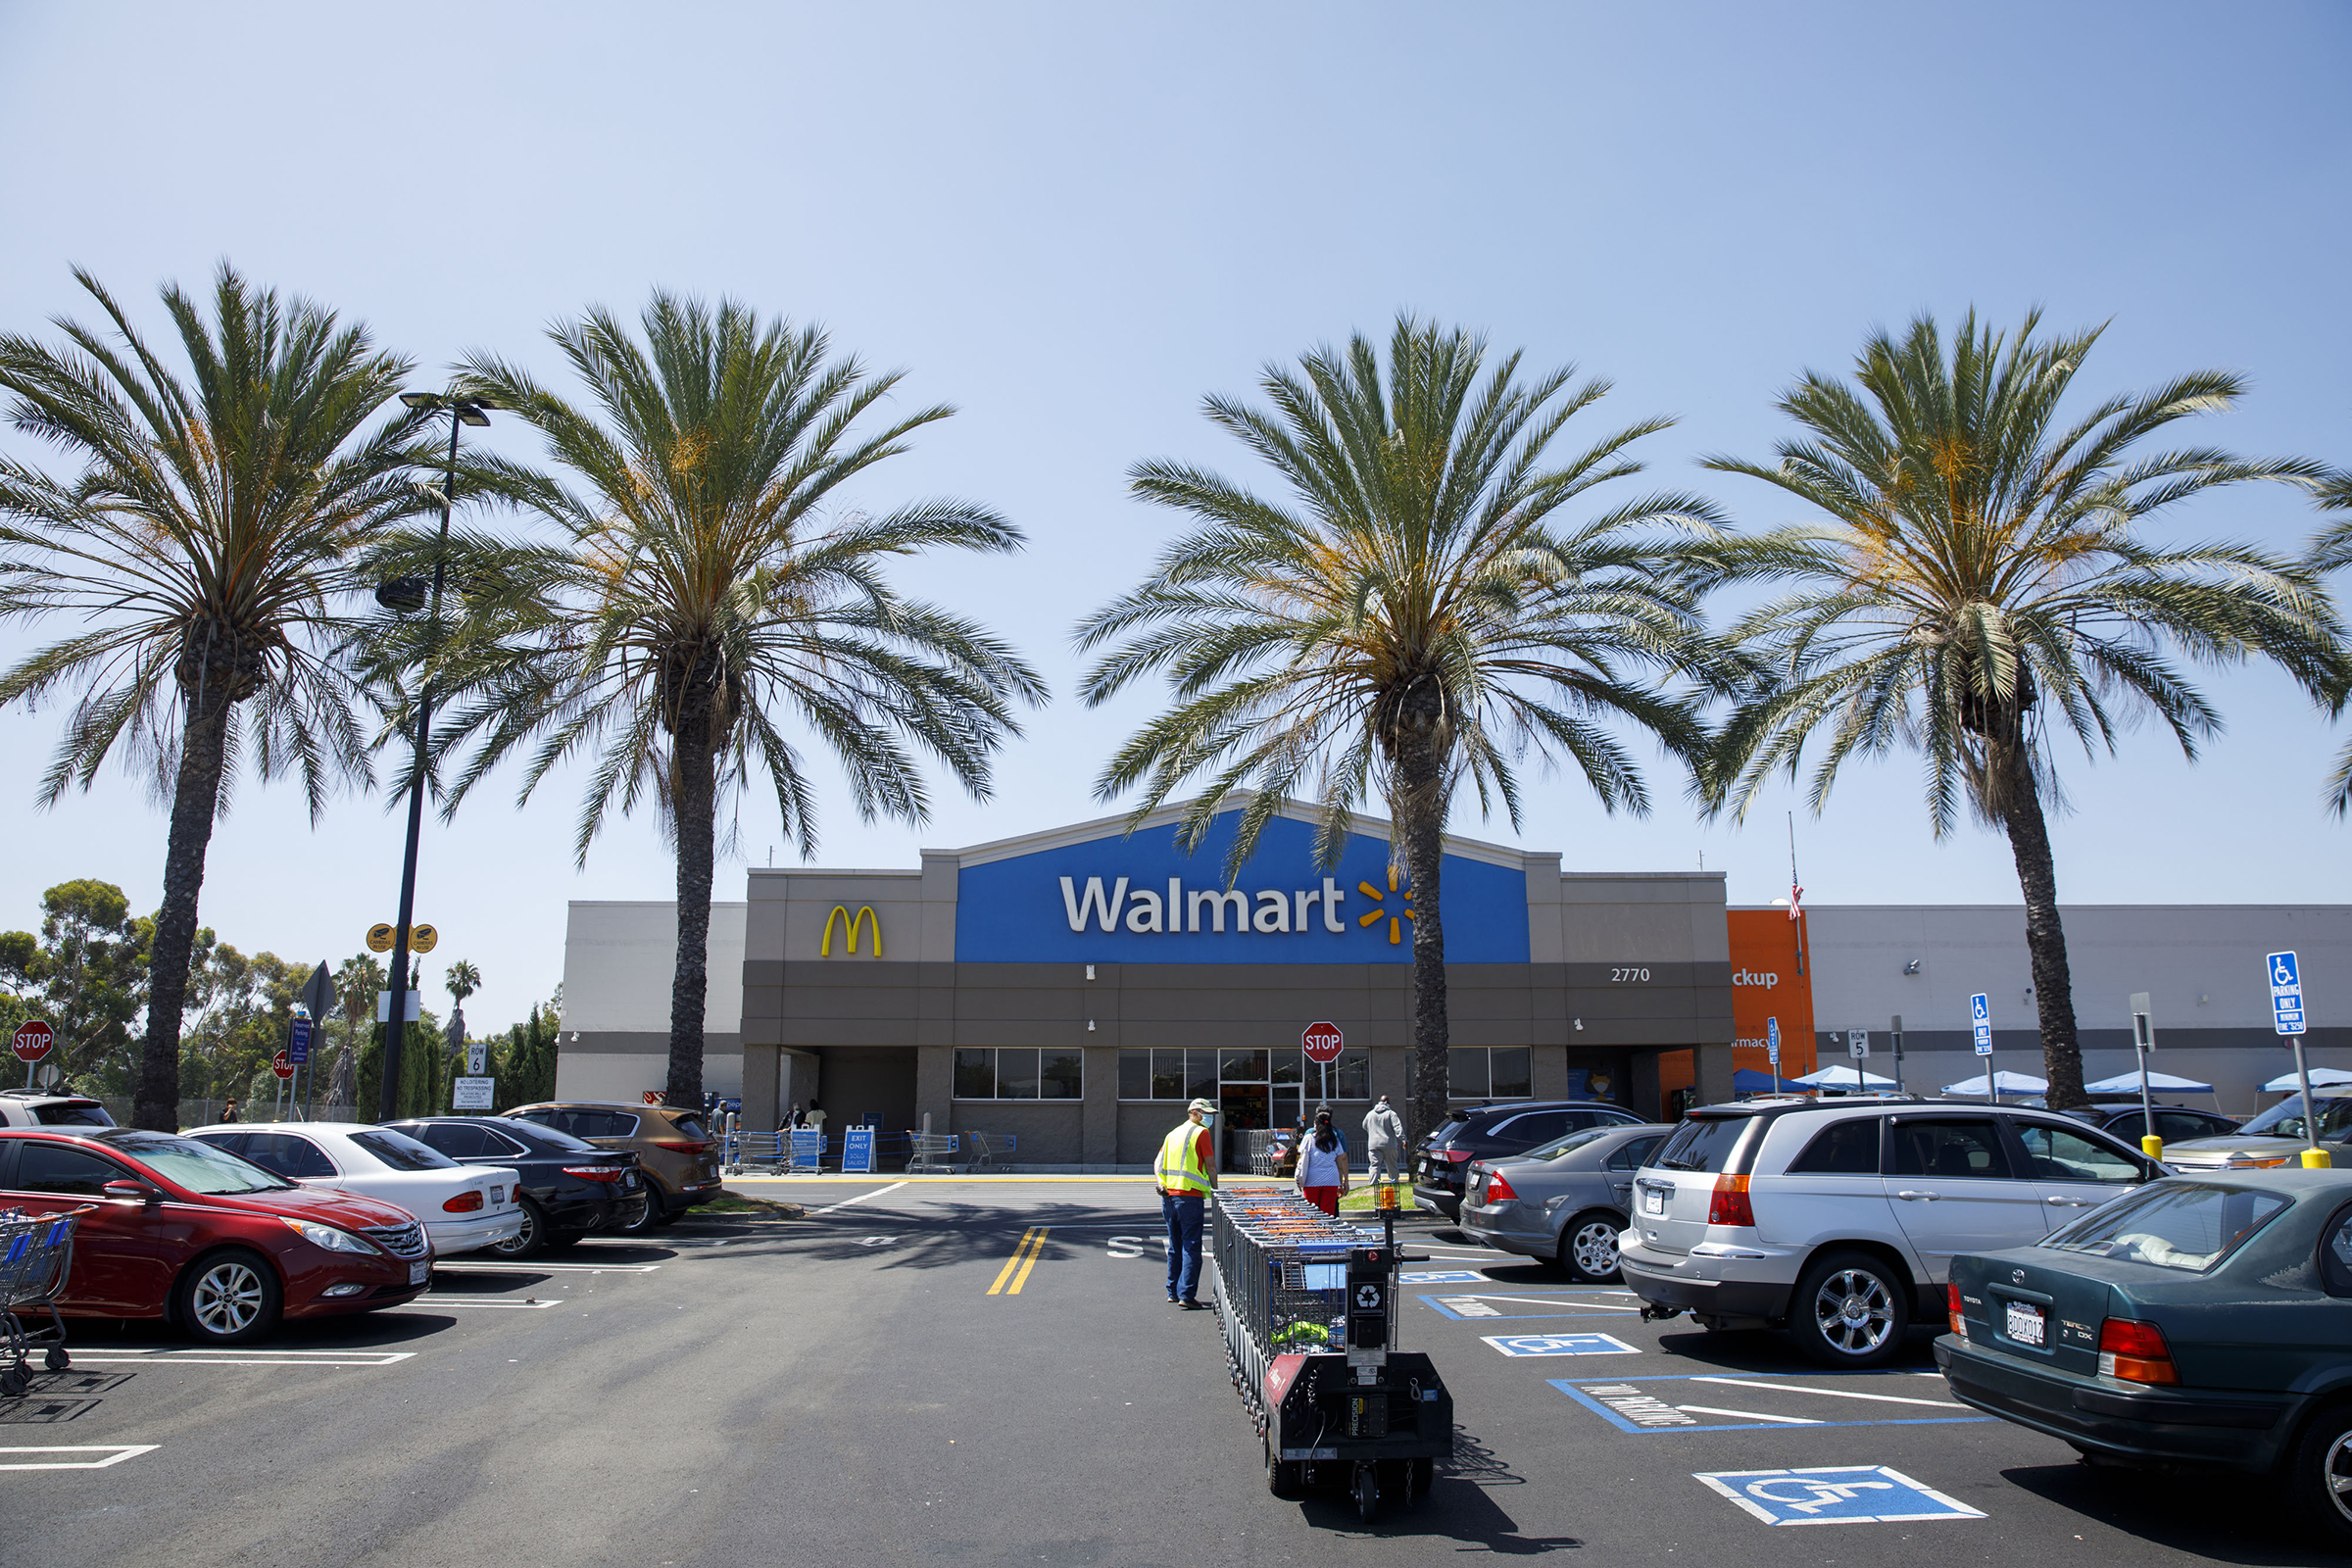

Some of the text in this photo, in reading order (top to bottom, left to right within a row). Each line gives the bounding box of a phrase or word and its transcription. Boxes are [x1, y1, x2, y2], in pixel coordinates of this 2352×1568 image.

[1058, 875, 1347, 933] Walmart
[1611, 968, 1650, 982] 2770
[1732, 968, 1779, 990] ckup
[2273, 984, 2300, 997] PARKING
[2278, 998, 2295, 1009] ONLY
[295, 1029, 309, 1038] Parking
[1851, 1032, 1865, 1041] ROW
[16, 1033, 51, 1049] STOP
[1305, 1035, 1340, 1051] STOP
[1731, 1038, 1771, 1051] rmacy
[1855, 1042, 1864, 1055] 5
[473, 1057, 480, 1071] 6
[1963, 1295, 1983, 1305] TOYOTA
[2008, 1314, 2044, 1340] 8DDX012
[2078, 1331, 2093, 1341] DX
[1599, 1396, 1697, 1426] PARKING
